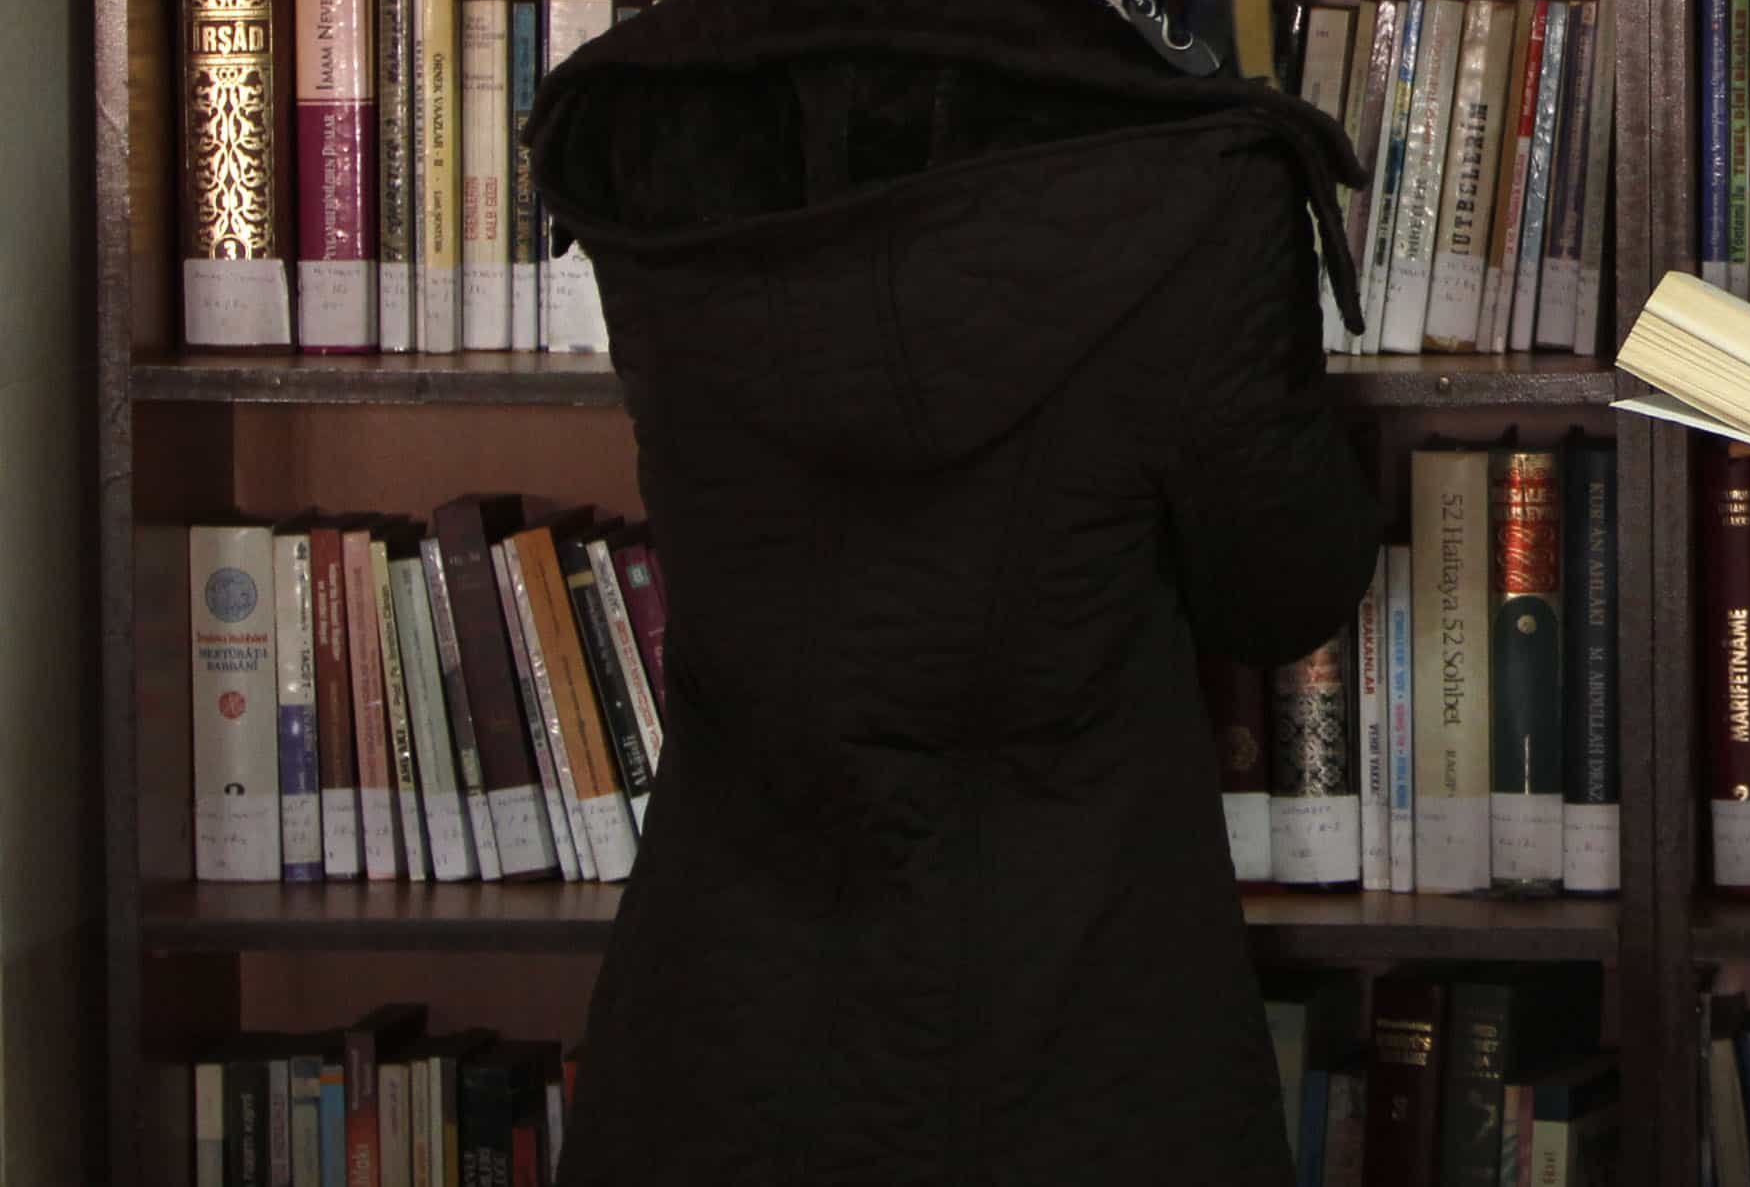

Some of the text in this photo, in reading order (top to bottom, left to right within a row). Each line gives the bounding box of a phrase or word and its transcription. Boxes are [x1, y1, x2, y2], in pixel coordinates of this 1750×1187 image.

[193, 20, 265, 55] İRŞÂD
[431, 52, 446, 149] ÖRNEK VAAZLAR
[1590, 481, 1607, 552] KUR'AN
[1438, 493, 1466, 727] 52 Haftaya 52 Sohbet
[1587, 670, 1608, 755] ABDULLAH
